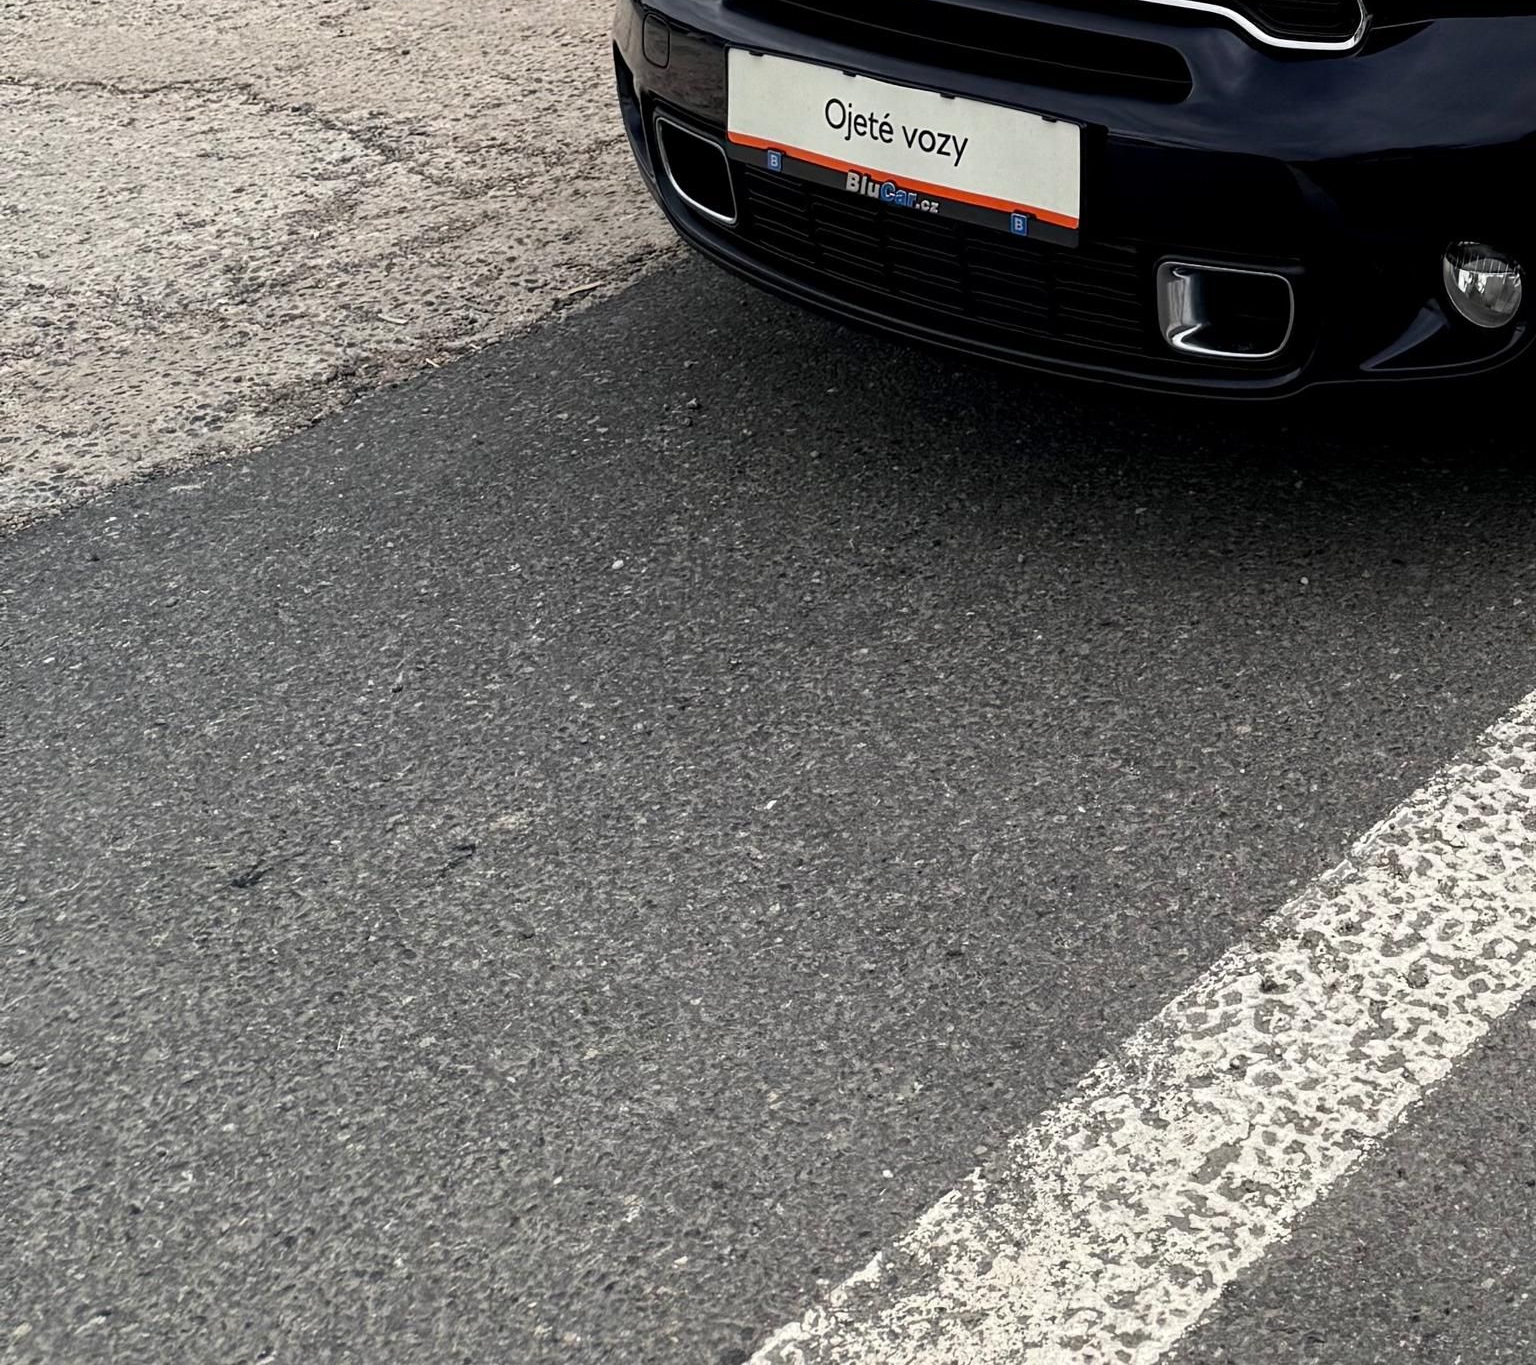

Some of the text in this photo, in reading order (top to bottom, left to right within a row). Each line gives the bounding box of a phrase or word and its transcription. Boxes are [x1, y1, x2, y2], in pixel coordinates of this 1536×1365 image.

[824, 98, 969, 167] Ojeté vozy
[845, 170, 939, 214] BluCar.cz
